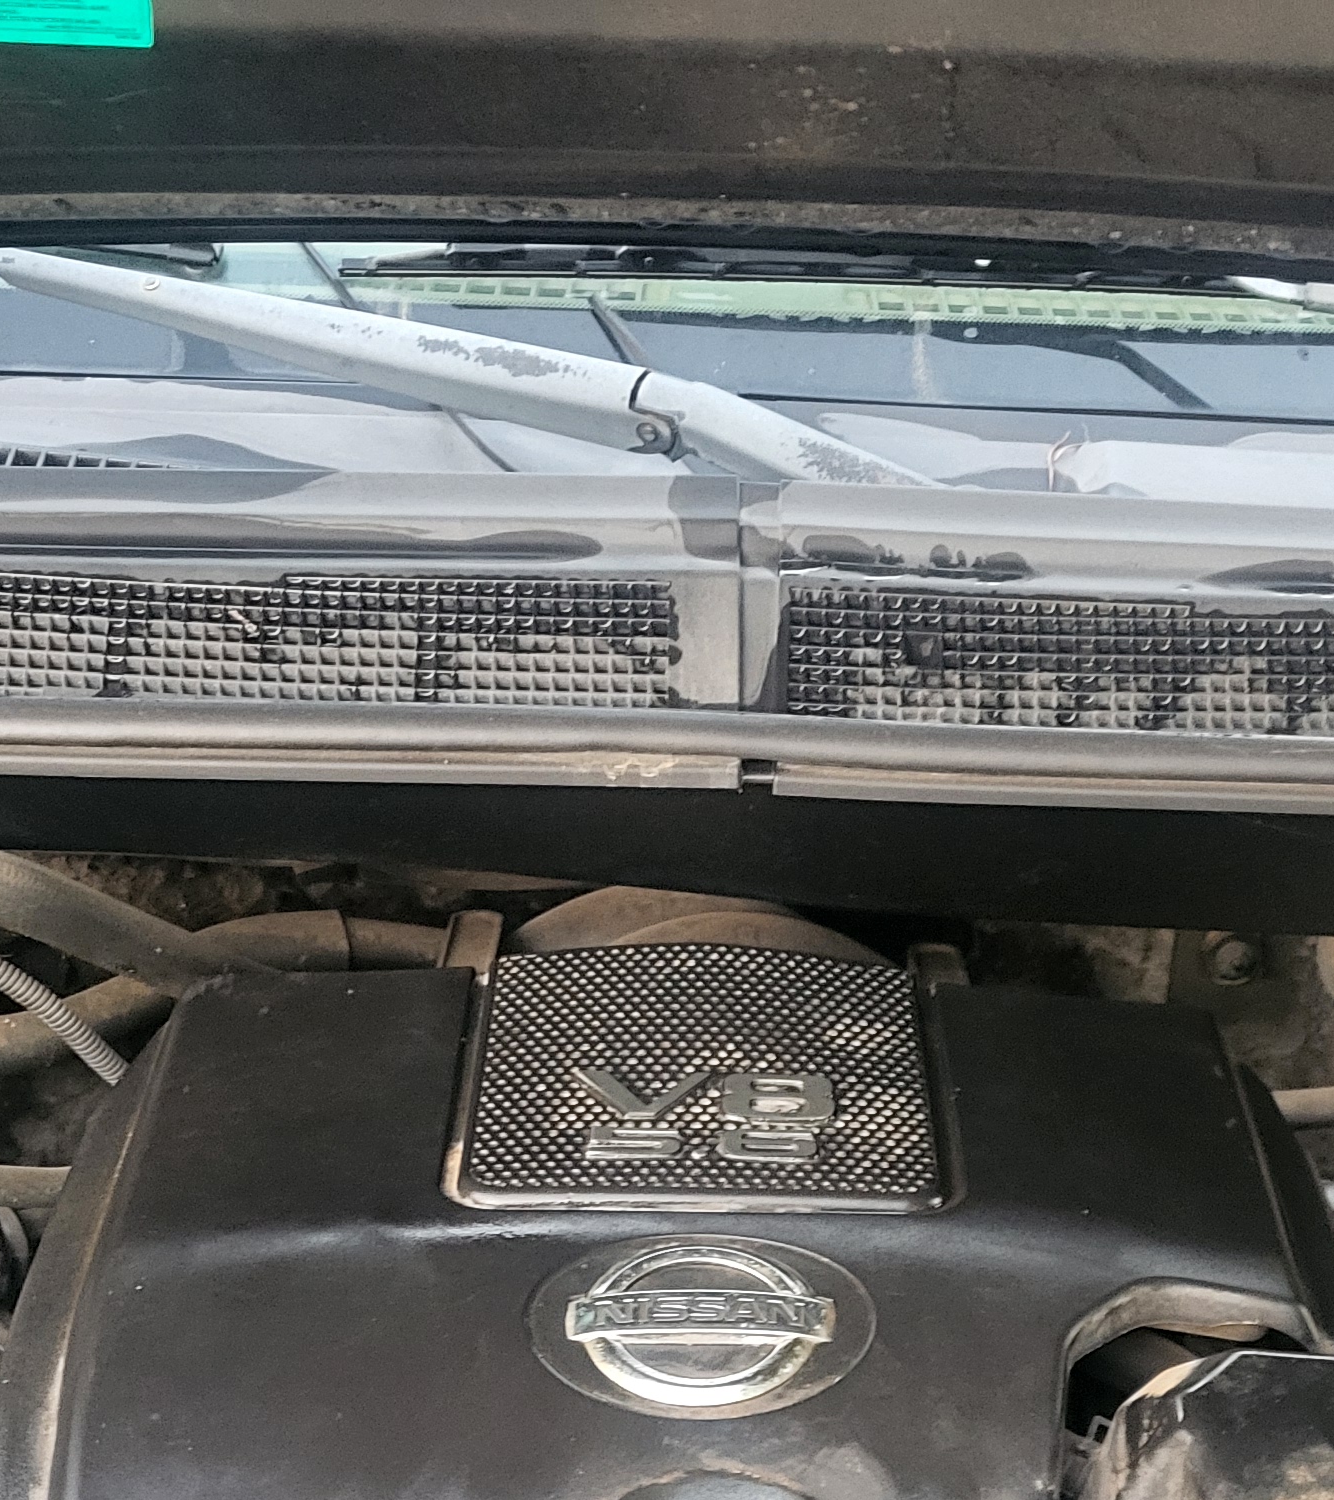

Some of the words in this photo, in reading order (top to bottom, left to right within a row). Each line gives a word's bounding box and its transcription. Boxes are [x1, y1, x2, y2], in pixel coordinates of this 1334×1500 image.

[570, 1067, 836, 1126] V8
[585, 1126, 821, 1164] 5.6
[593, 1296, 807, 1328] NISSAN
